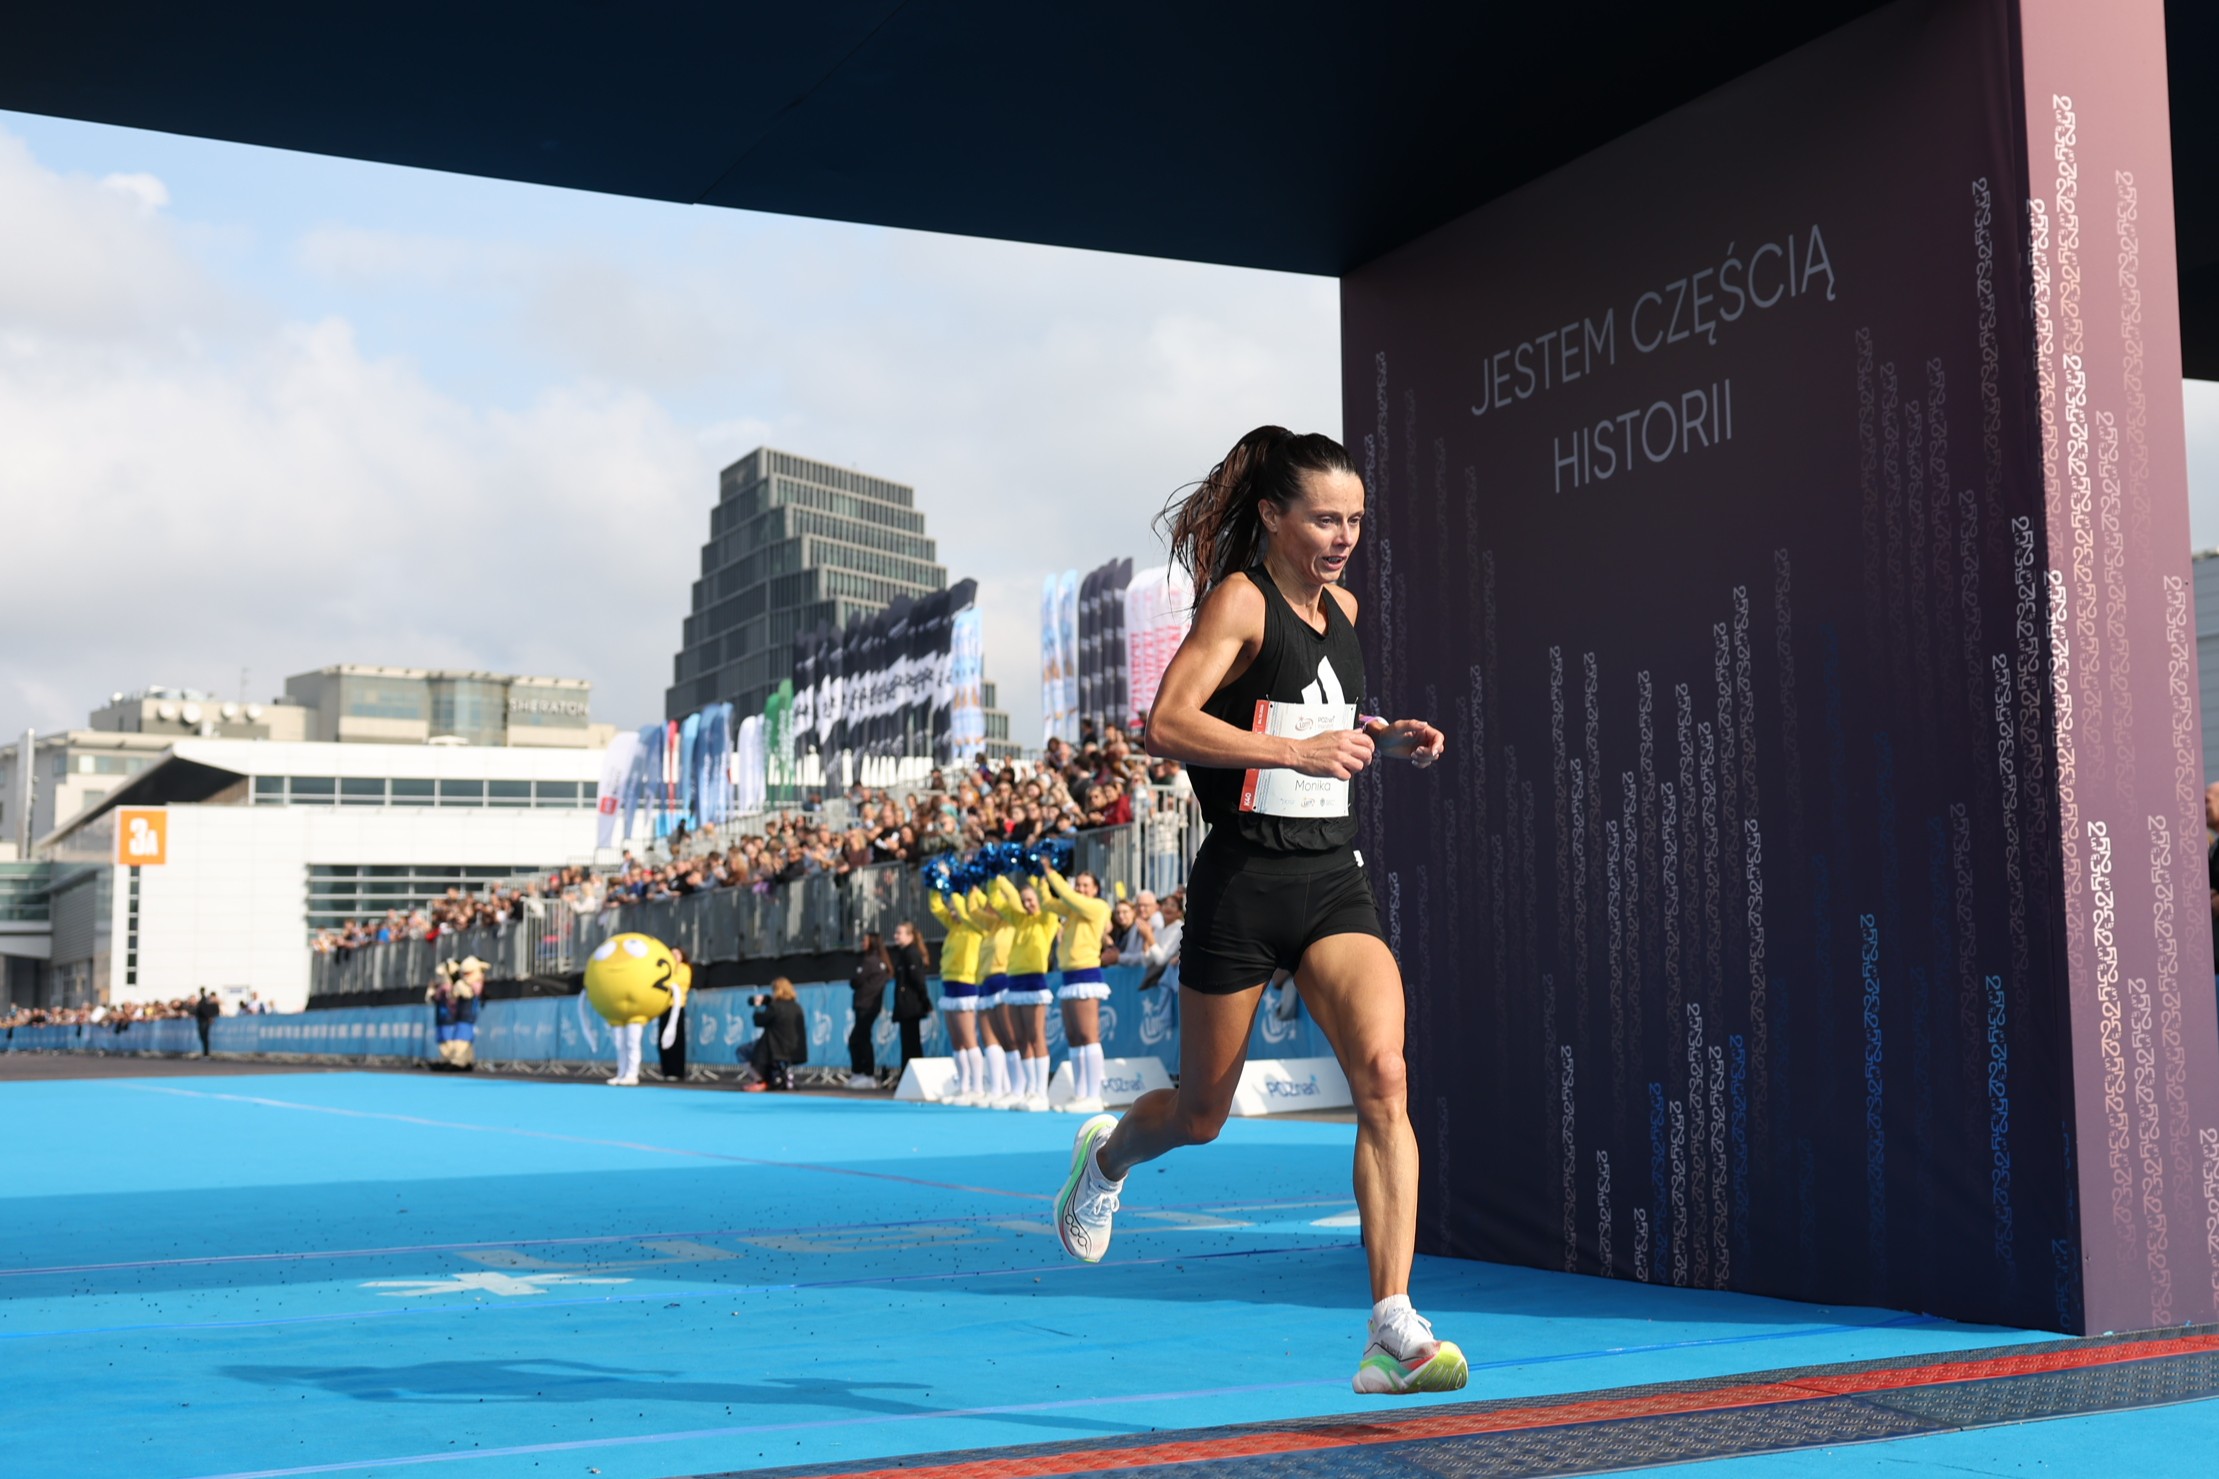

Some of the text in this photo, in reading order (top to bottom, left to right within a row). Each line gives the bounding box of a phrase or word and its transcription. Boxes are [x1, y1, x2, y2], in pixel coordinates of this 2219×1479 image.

[1471, 224, 1836, 416] JESTEM CZĘŚCIĄ
[1554, 379, 1732, 493] HISTORII
[1295, 780, 1331, 791] Monika
[129, 817, 159, 856] 3A
[652, 957, 673, 993] 2
